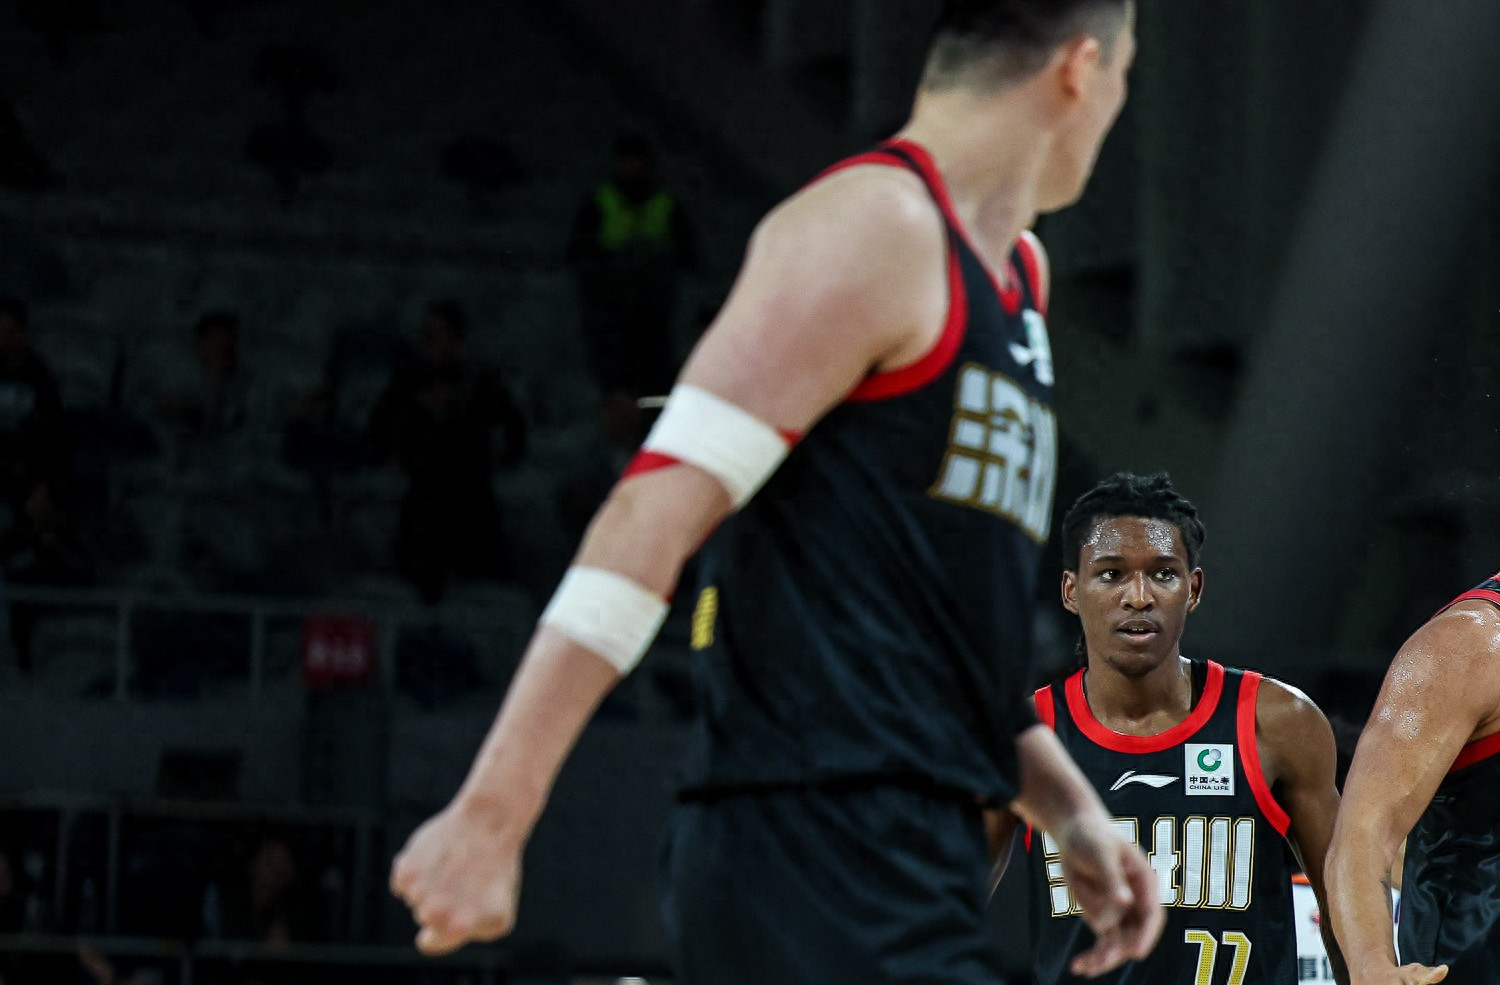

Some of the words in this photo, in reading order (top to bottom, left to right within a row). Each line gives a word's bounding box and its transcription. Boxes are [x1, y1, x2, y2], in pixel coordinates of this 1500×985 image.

[1189, 776, 1230, 785] 中国人寿
[1041, 815, 1256, 917] 圳
